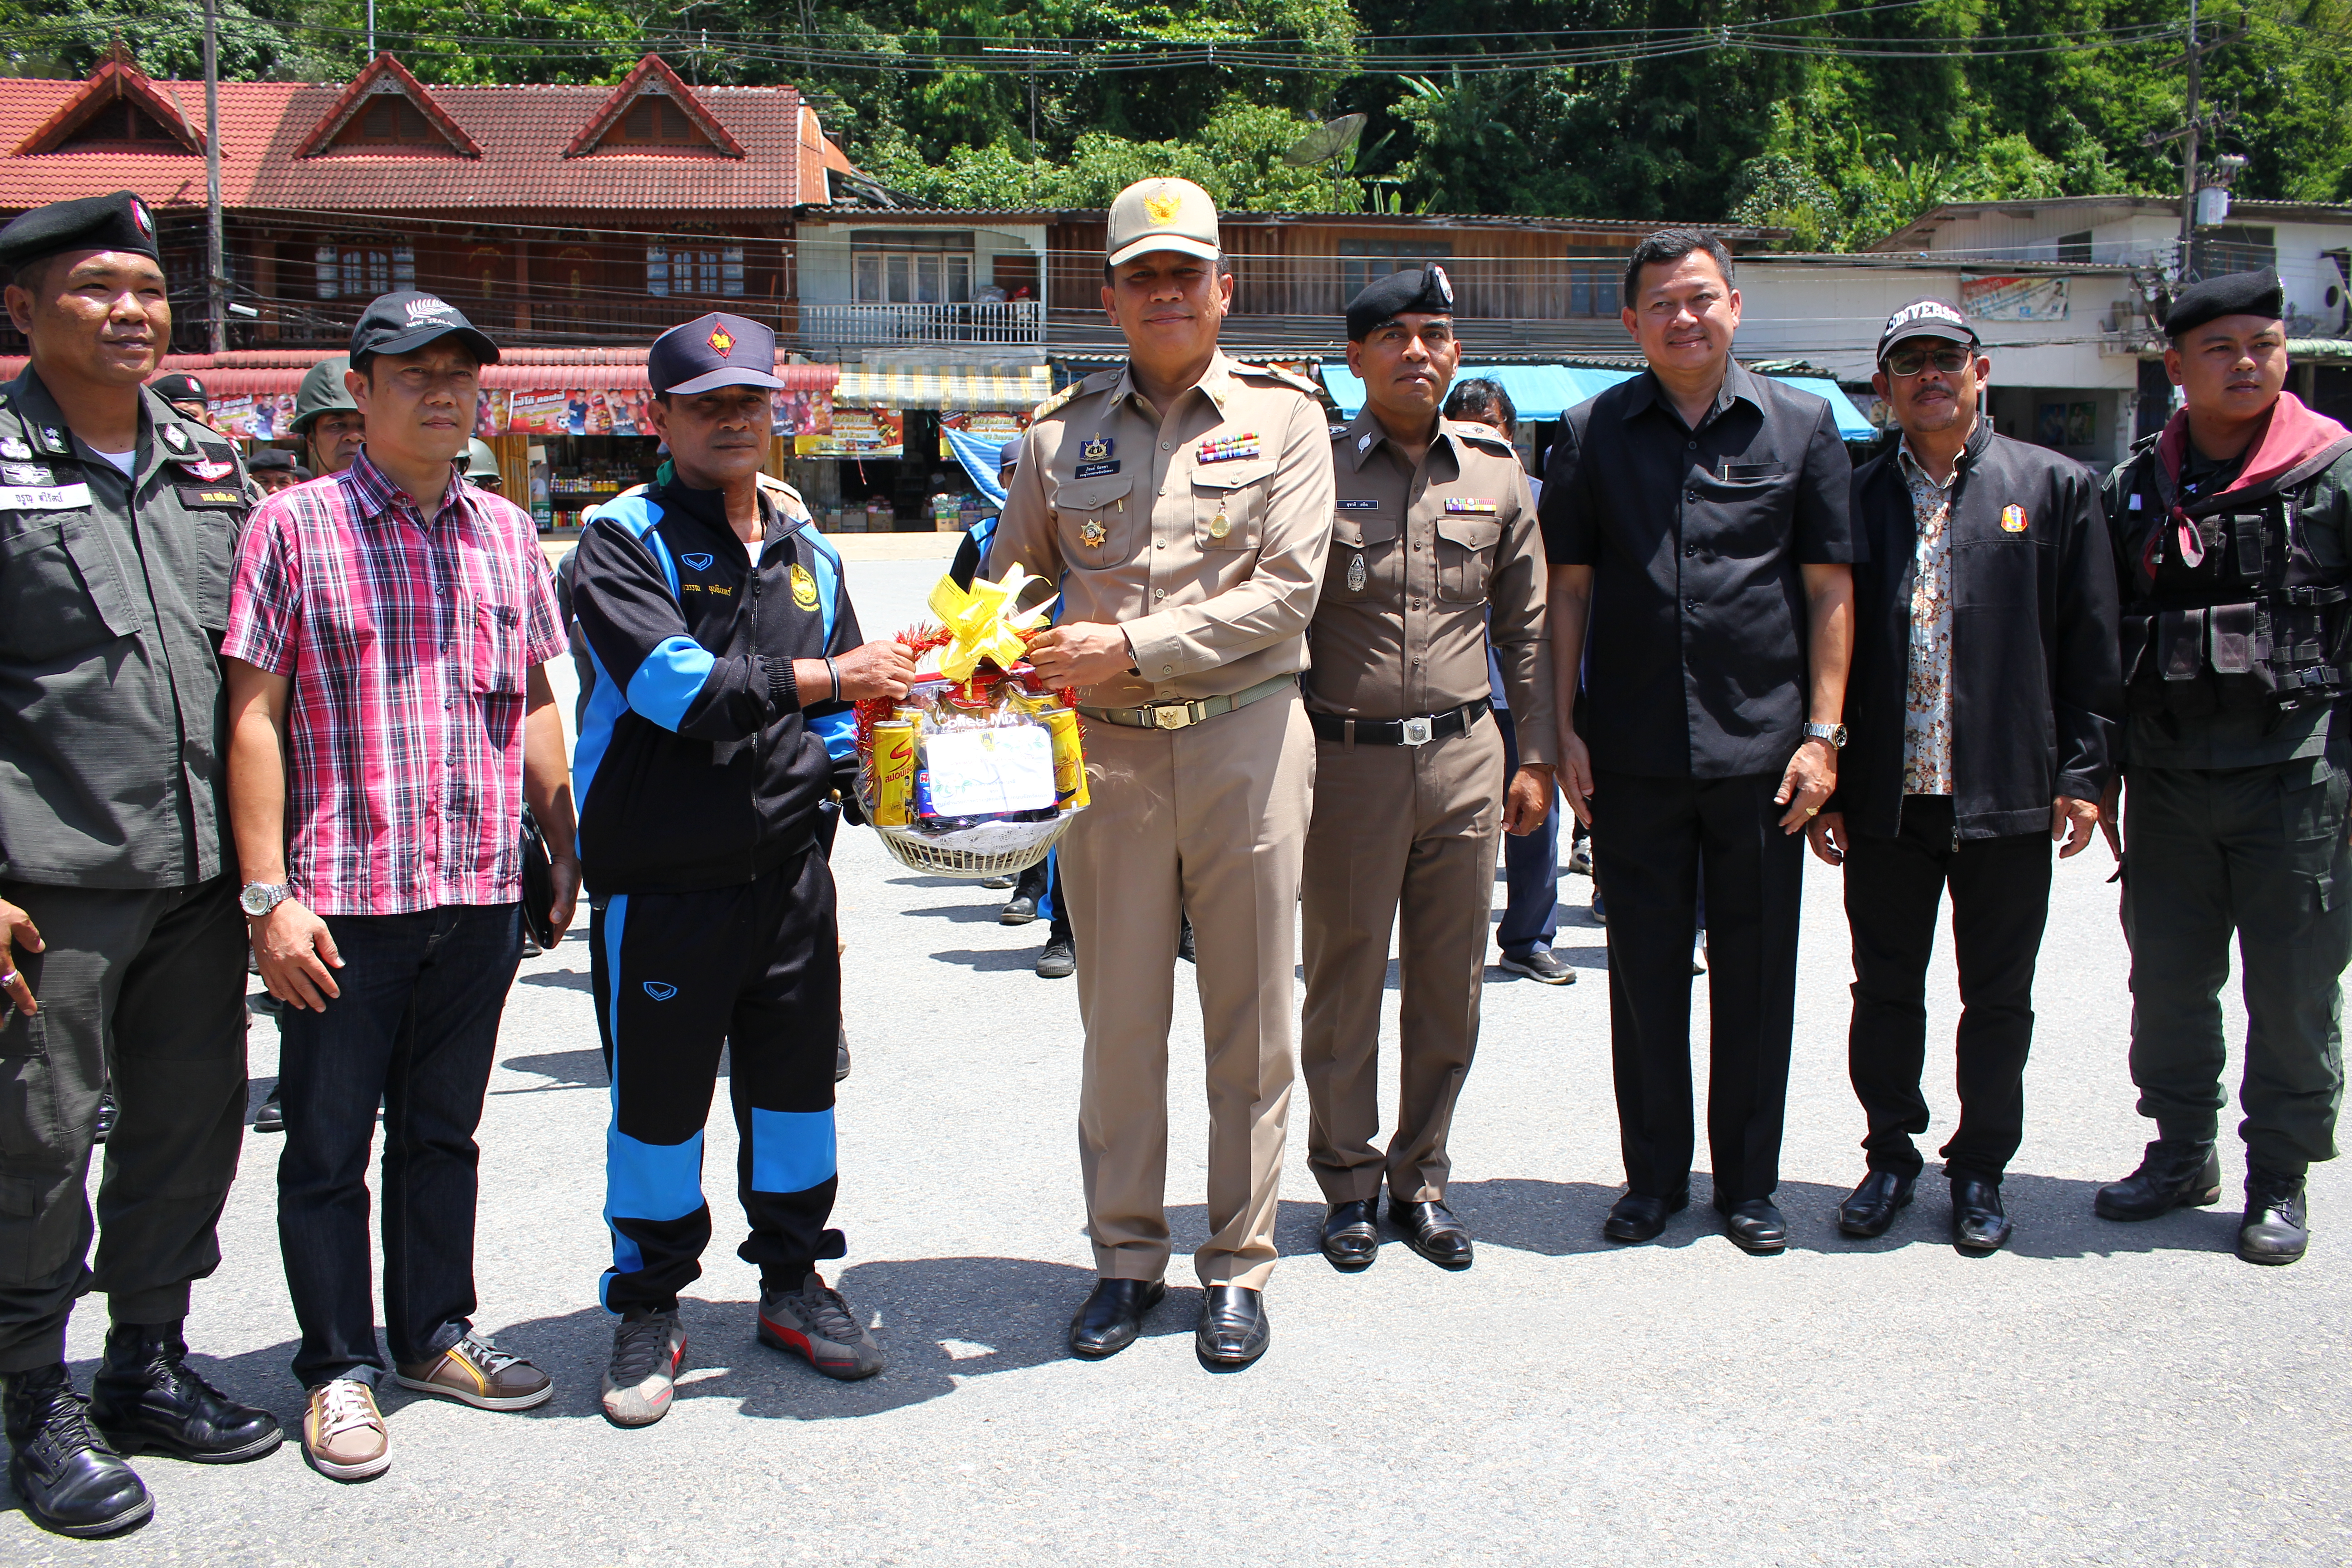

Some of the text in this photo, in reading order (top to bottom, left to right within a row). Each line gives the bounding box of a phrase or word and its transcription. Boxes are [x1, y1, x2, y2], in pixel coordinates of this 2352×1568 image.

[406, 319, 424, 328] NEW
[1885, 301, 1963, 336] CONVERSE
[937, 711, 1019, 728] Coffee Mix
[885, 763, 914, 783] สปอนเซอ
